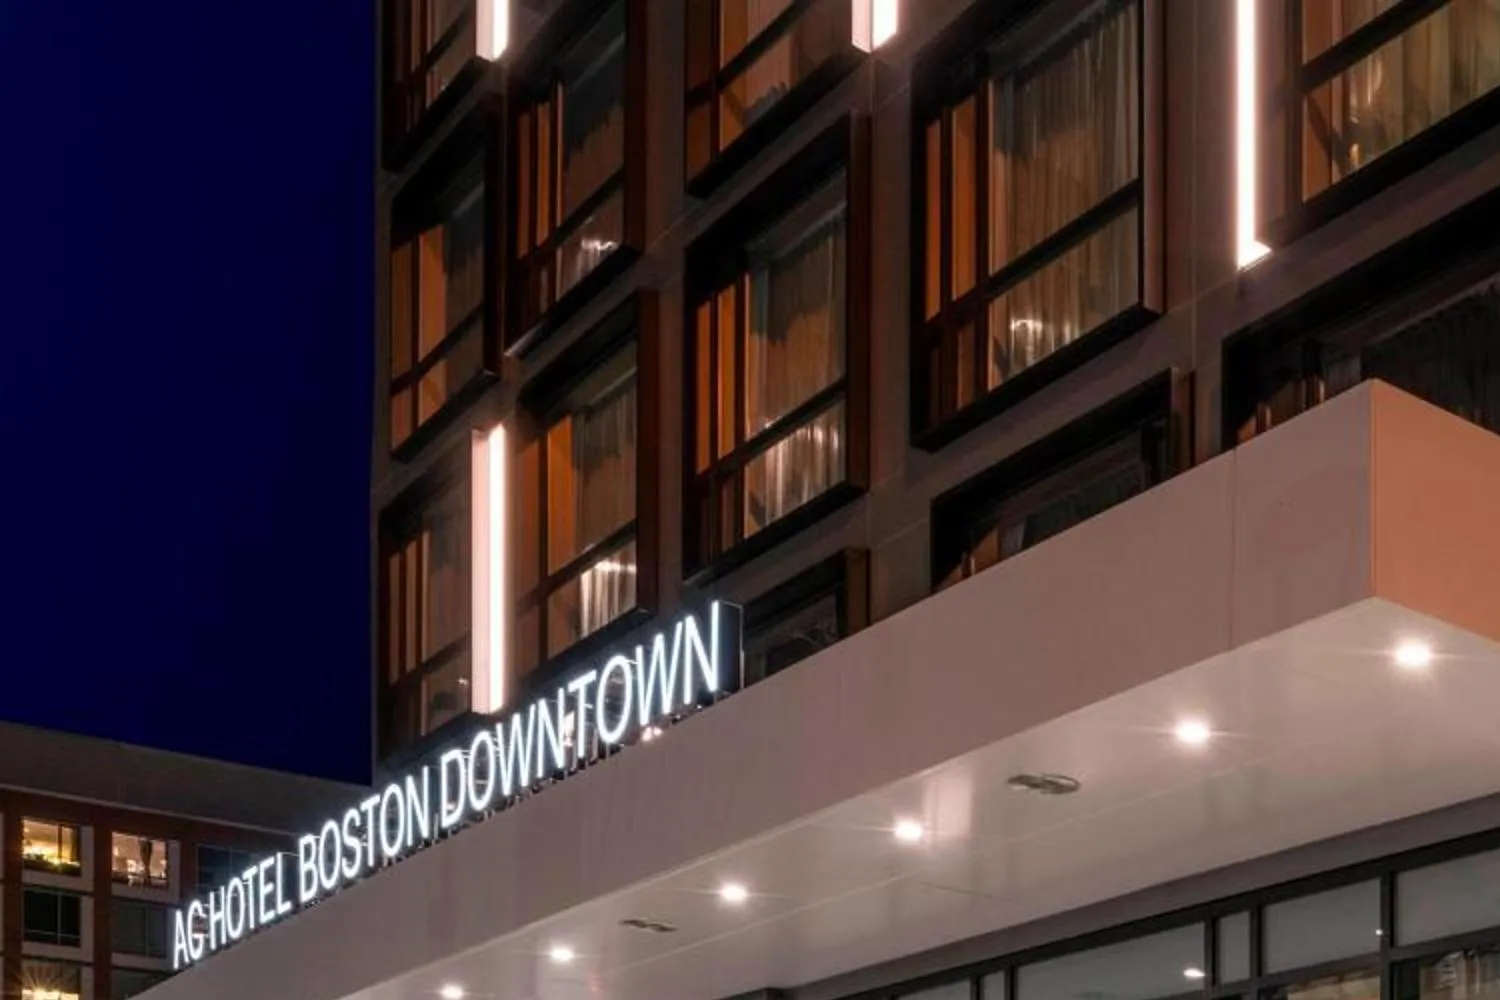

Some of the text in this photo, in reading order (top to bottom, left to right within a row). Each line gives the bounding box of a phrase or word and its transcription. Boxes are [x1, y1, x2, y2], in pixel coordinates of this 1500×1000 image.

[172, 600, 720, 970] AC HOTEL BOSTON DOWNTOWN
